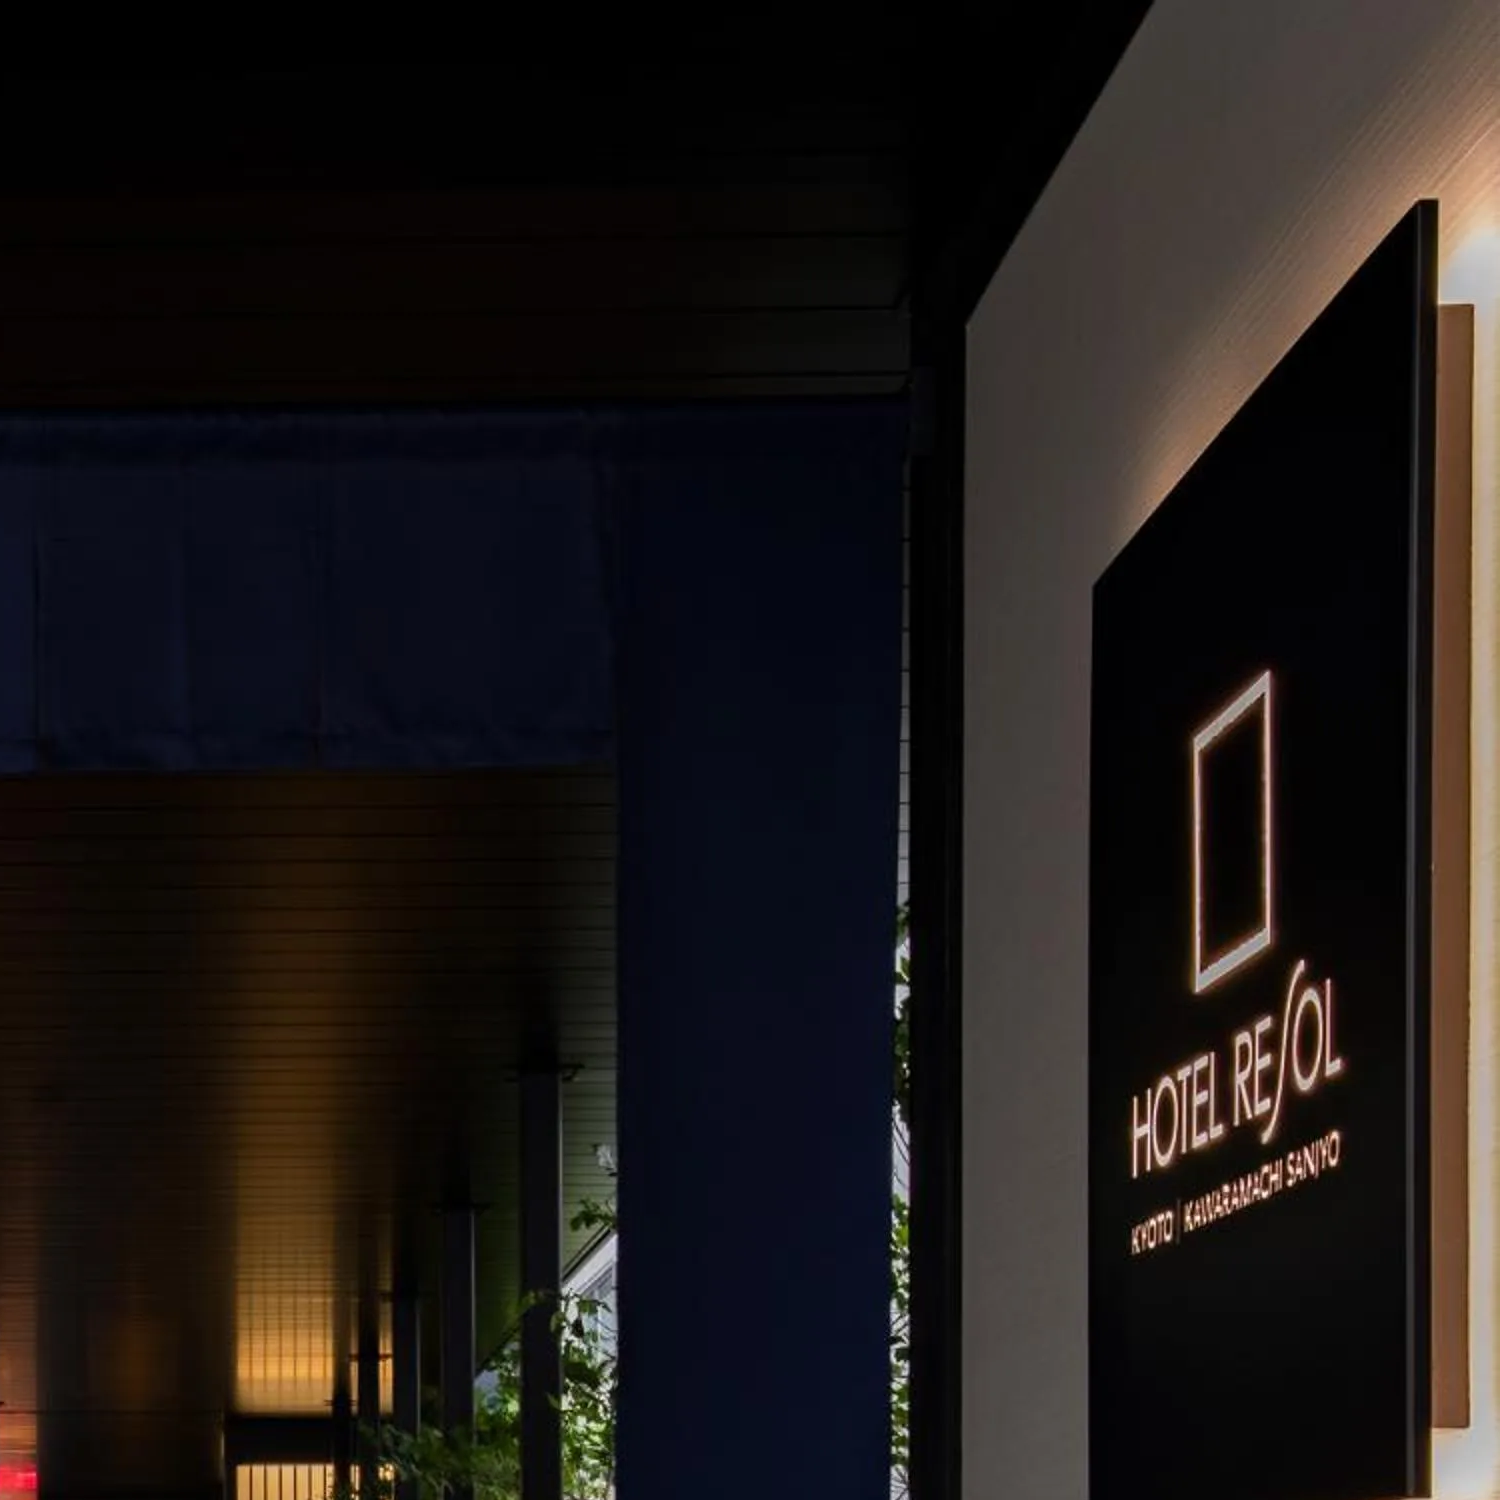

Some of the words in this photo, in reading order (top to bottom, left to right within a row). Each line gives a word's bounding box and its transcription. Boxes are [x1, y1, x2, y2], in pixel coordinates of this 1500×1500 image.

[1132, 1051, 1224, 1179] HOTEL
[1233, 959, 1343, 1144] RESOL
[1131, 1210, 1174, 1255] KYOTO
[1184, 1158, 1283, 1232] KAWARAMACHI
